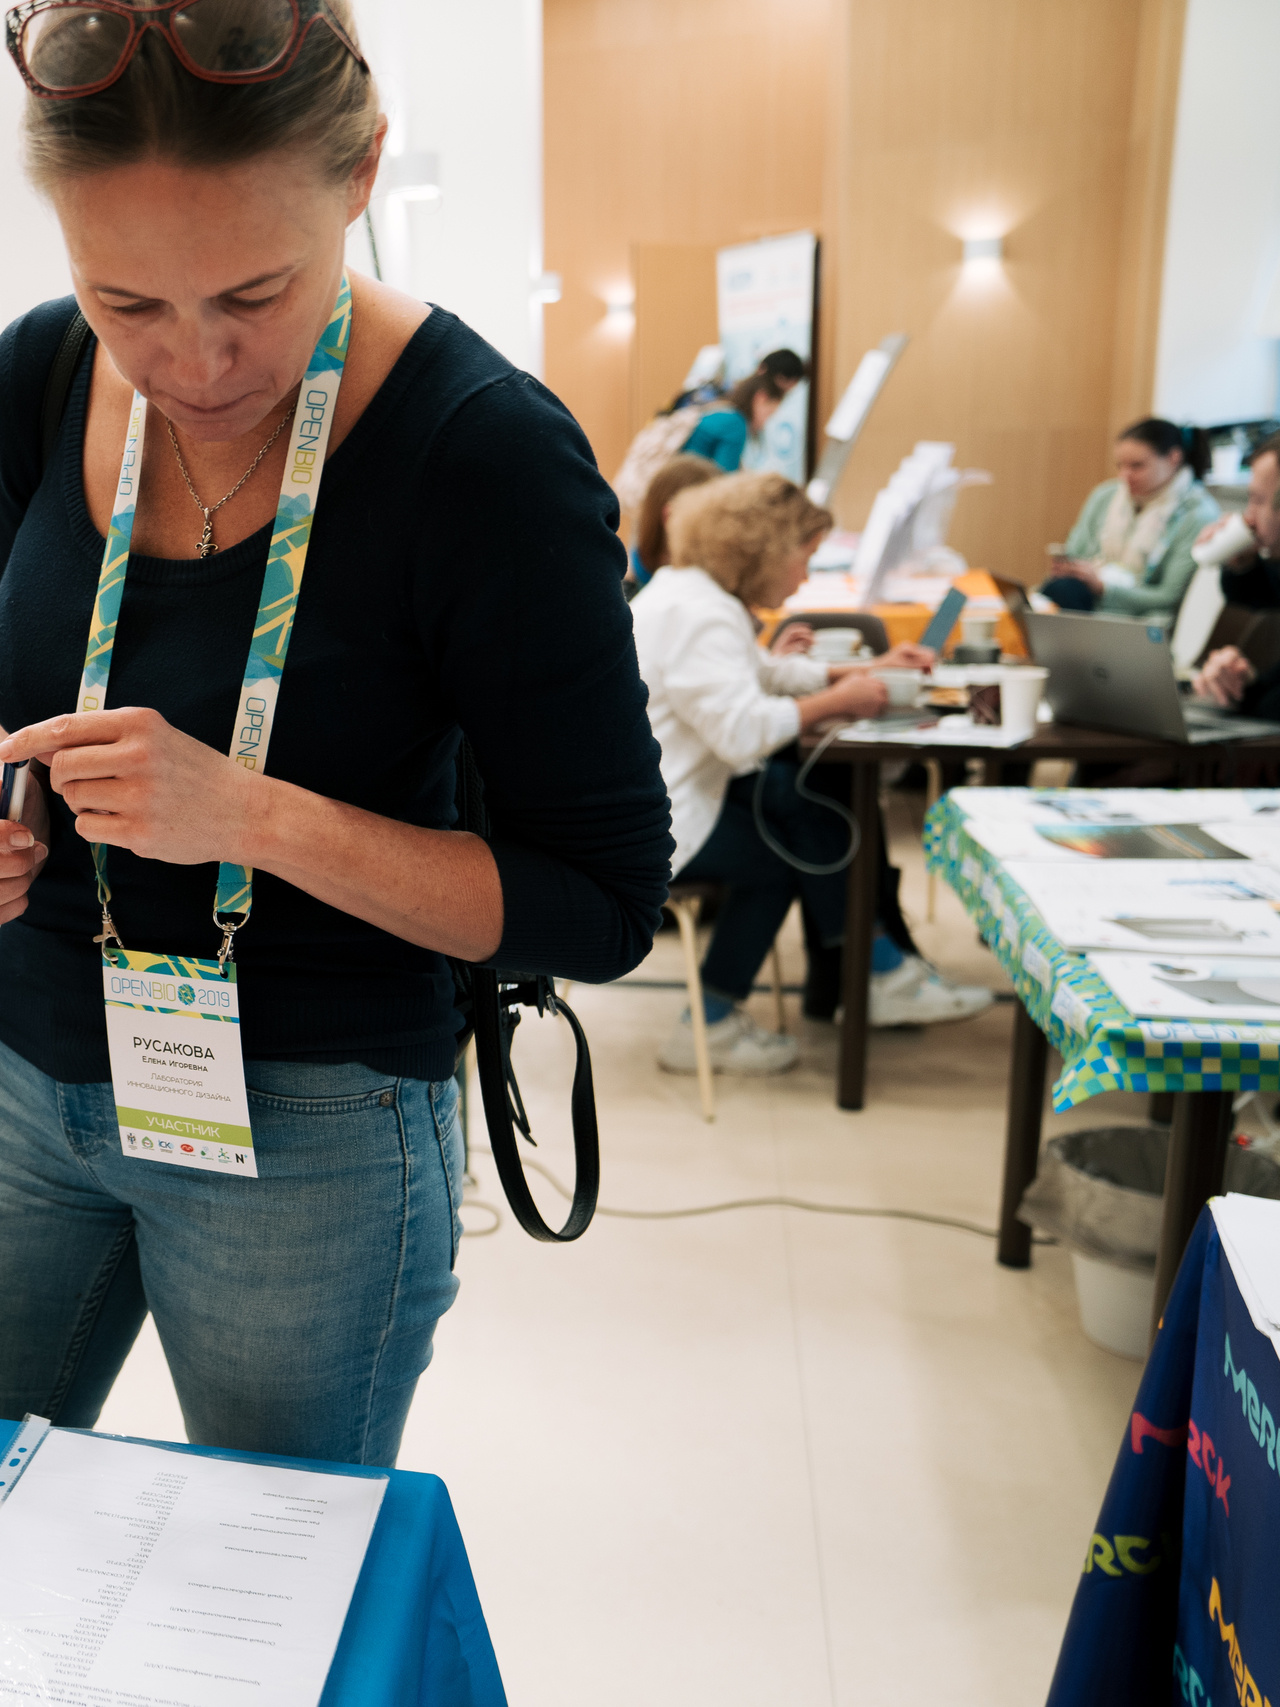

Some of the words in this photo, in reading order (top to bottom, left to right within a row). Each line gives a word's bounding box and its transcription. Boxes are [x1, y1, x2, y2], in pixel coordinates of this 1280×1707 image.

[118, 406, 141, 496] OPENBIO
[291, 389, 328, 485] OPENBIO
[235, 696, 267, 771] OPENB
[110, 976, 177, 1003] OPENBIO
[197, 988, 231, 1008] 2019
[133, 1036, 215, 1061] РУСАКОВА
[145, 1115, 221, 1138] УЧАСТНИК
